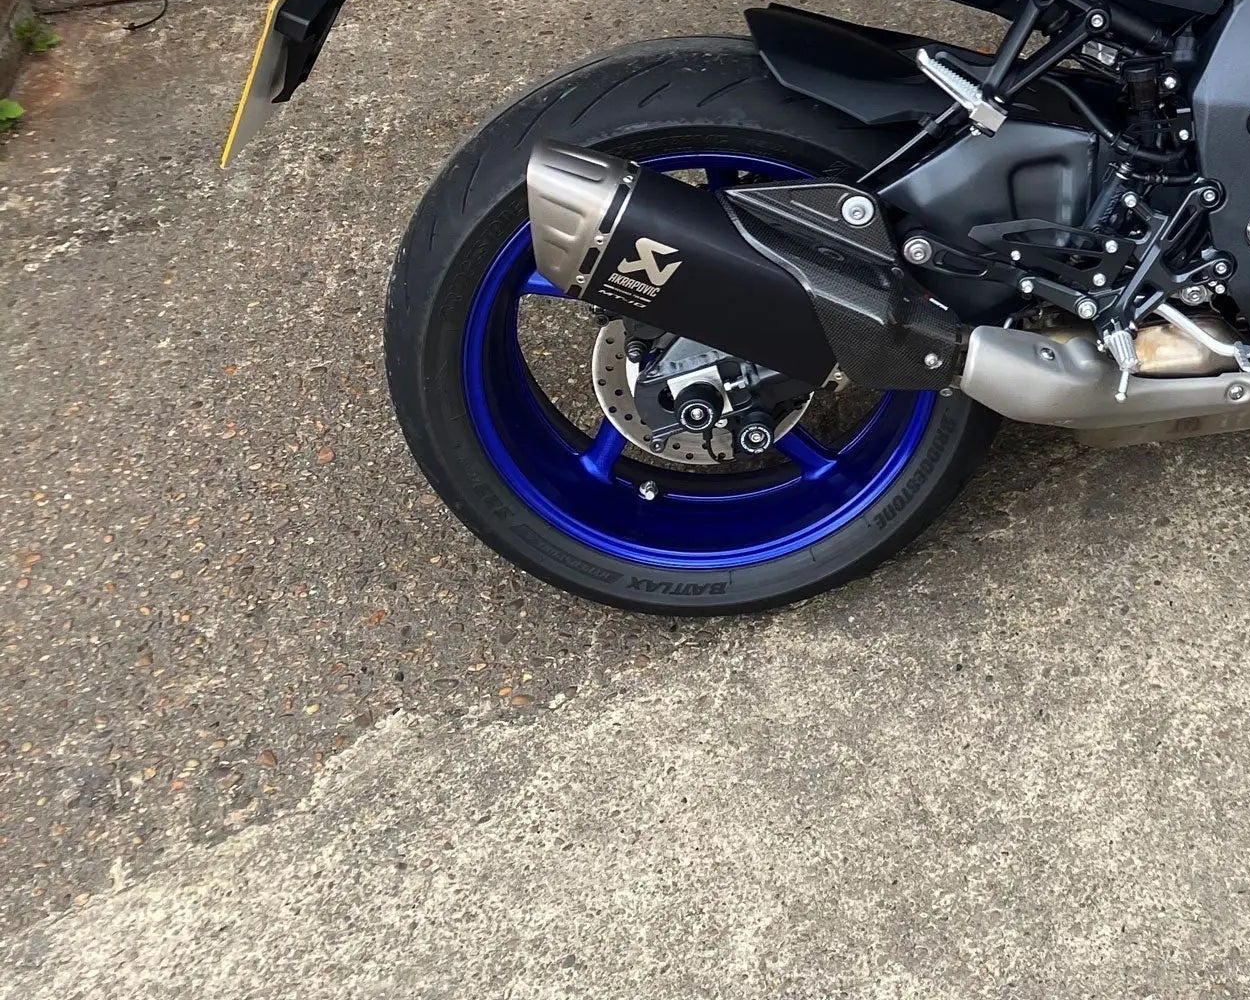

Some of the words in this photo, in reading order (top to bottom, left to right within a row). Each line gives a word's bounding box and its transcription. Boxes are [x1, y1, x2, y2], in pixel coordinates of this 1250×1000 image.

[608, 272, 661, 298] AKRAPOVIC
[598, 289, 646, 308] MT-10
[626, 576, 727, 596] BATTLAX
